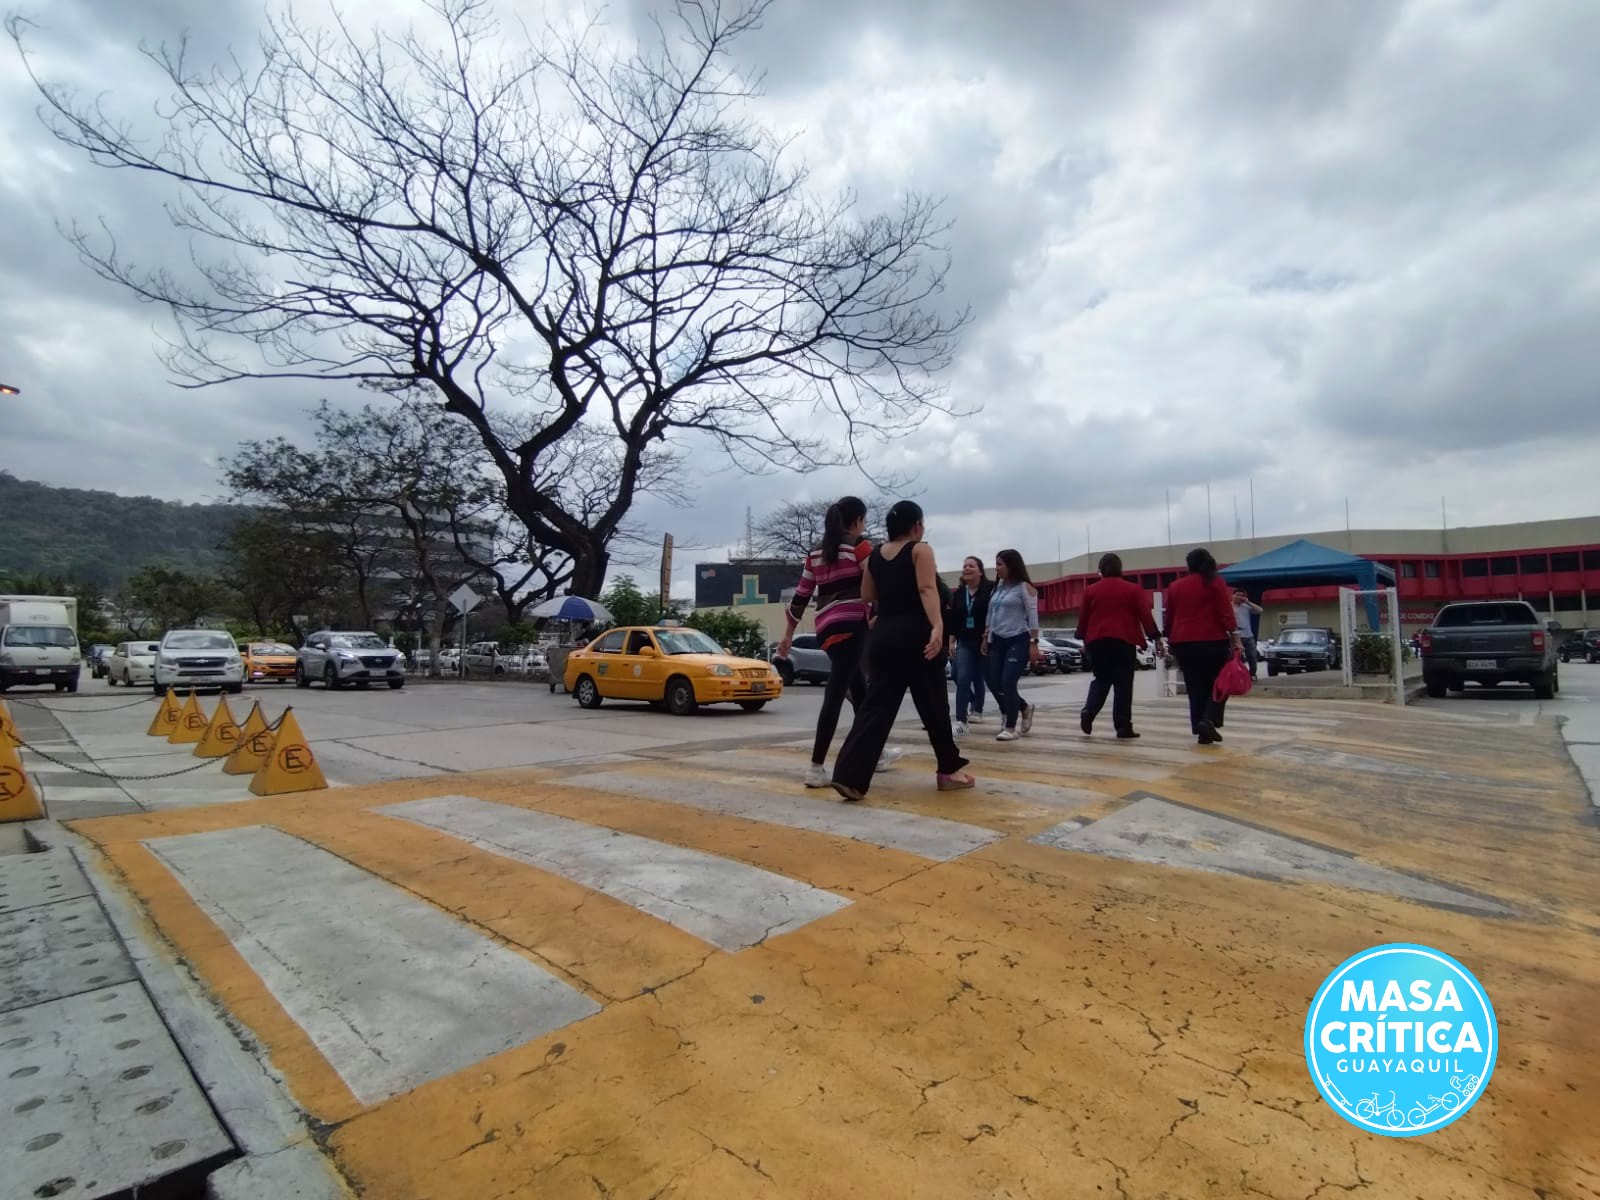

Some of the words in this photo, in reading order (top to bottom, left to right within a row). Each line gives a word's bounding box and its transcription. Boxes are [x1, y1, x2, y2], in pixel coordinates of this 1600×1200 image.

[188, 715, 199, 728] E
[220, 726, 234, 740] E
[252, 735, 268, 752] E
[285, 748, 302, 769] E
